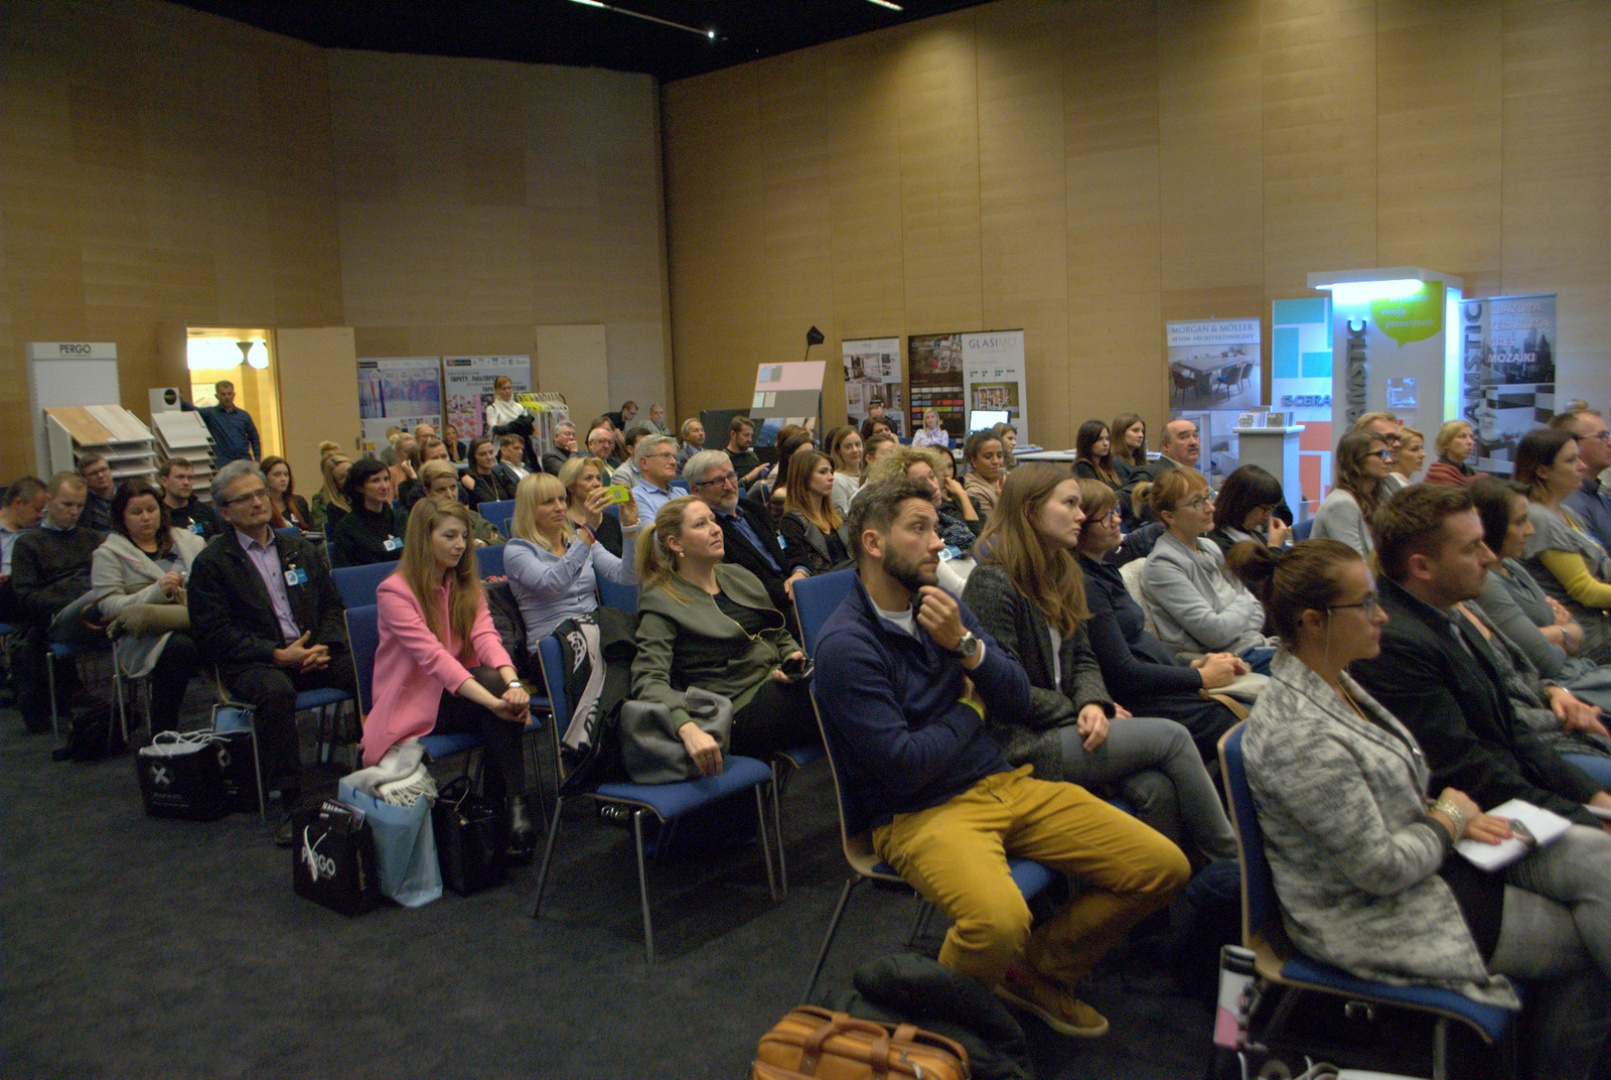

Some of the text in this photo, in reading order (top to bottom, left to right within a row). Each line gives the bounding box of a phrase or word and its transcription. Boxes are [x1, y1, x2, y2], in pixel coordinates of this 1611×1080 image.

[1489, 302, 1541, 314] GLAZURA
[1172, 324, 1209, 334] MORGAN
[1211, 324, 1217, 332] &
[1490, 318, 1550, 330] TERAKOTA
[1489, 336, 1515, 347] GRES
[59, 343, 92, 354] PERGO
[1489, 351, 1536, 363] MOZAIKI
[1464, 303, 1482, 466] AMSTIC
